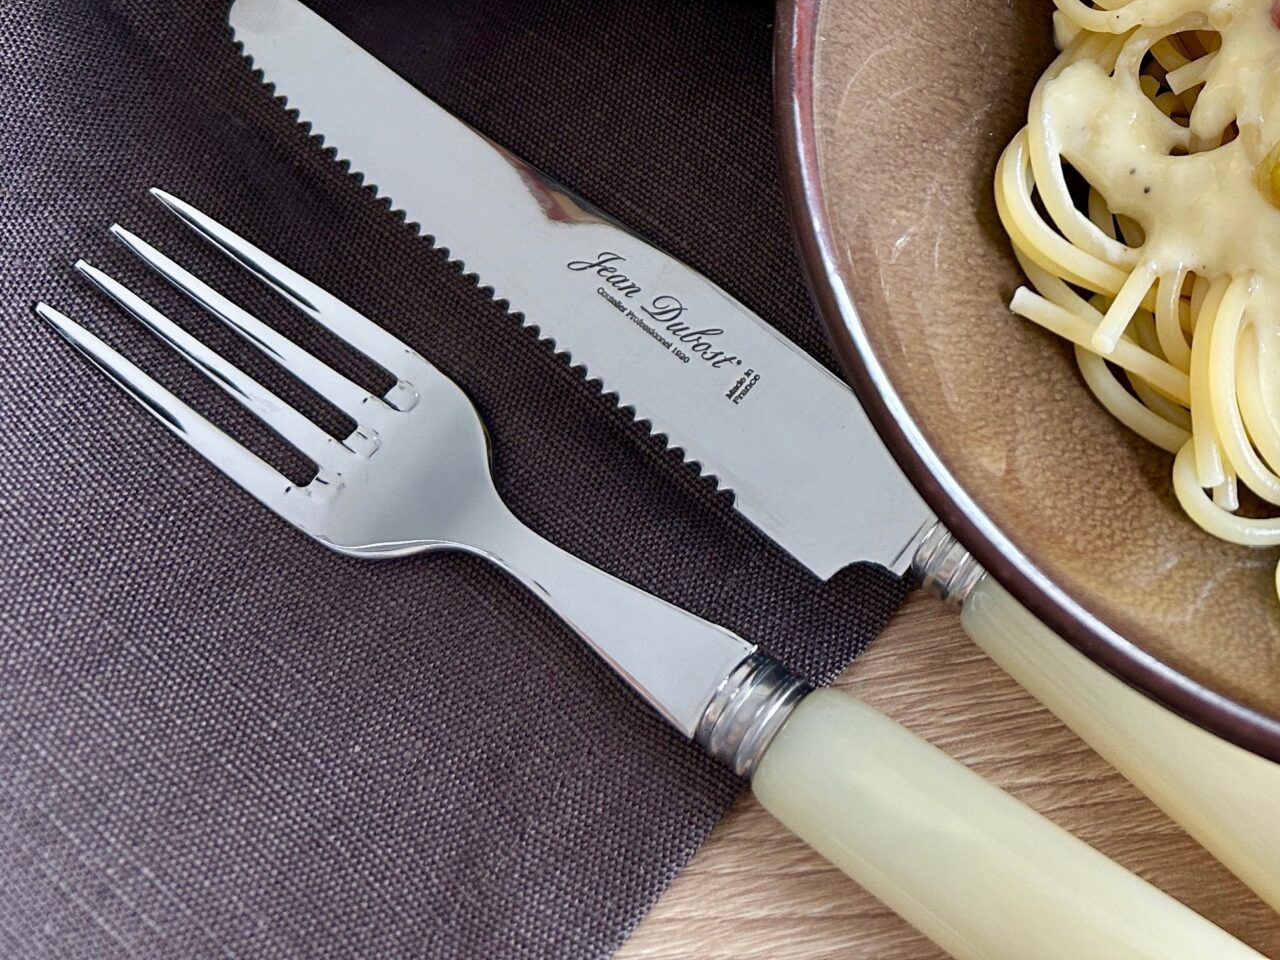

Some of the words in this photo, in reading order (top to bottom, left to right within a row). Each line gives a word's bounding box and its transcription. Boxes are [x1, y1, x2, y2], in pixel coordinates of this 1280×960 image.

[567, 251, 642, 298] Jean
[640, 295, 738, 369] Dubost
[725, 377, 746, 400] Made
[744, 369, 754, 378] in
[732, 374, 761, 405] France
